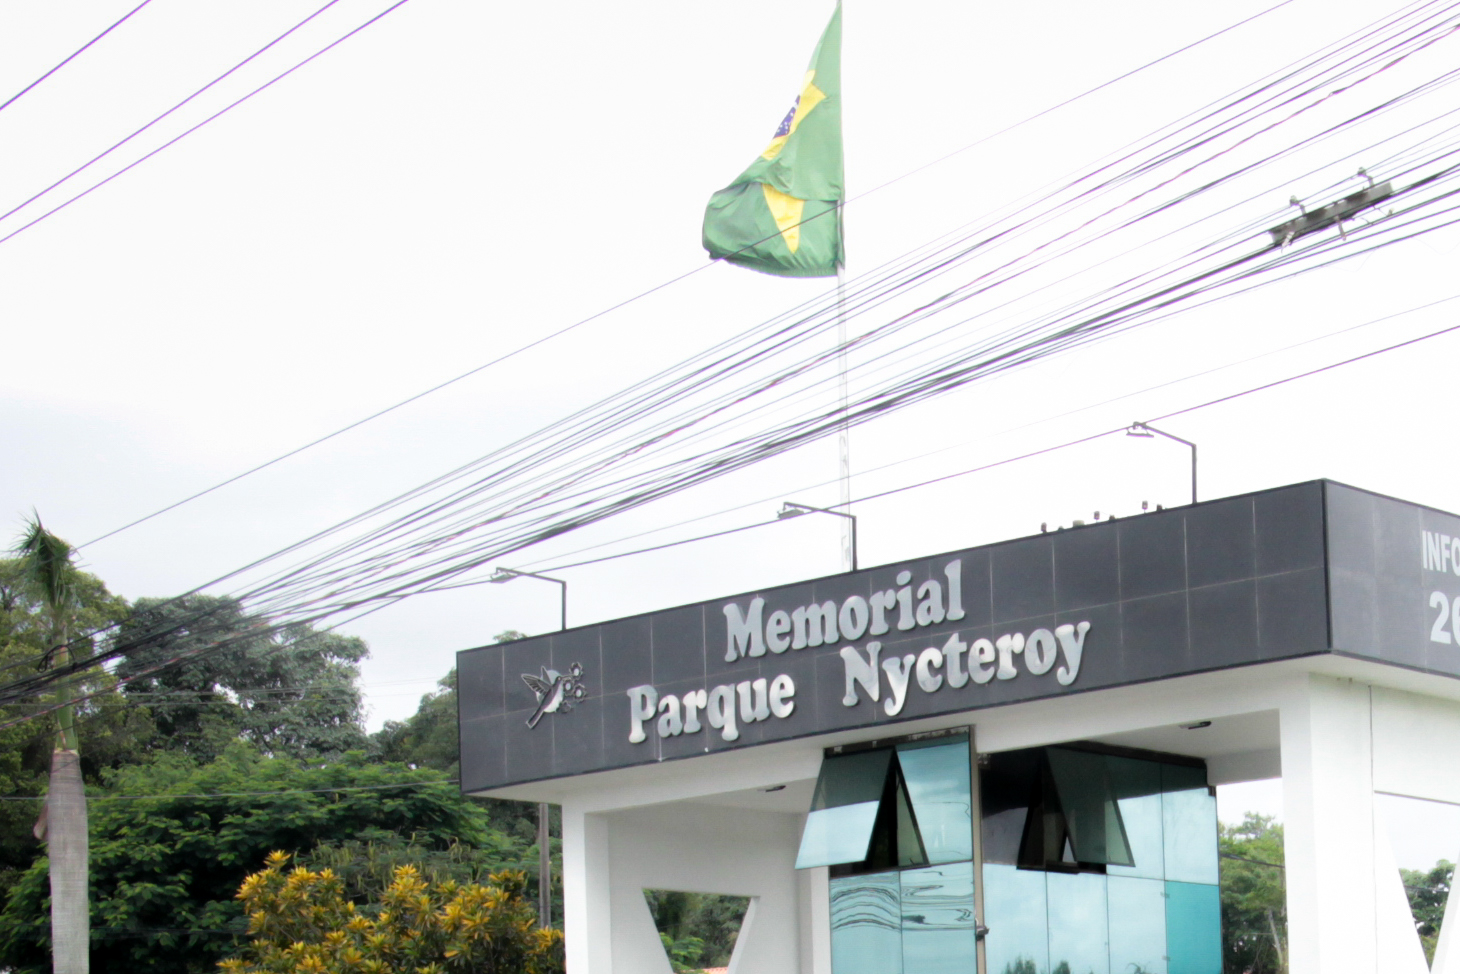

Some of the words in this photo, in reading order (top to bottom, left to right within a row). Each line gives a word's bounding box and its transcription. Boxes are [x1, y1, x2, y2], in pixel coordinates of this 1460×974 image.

[723, 559, 965, 662] Memorial
[627, 673, 796, 743] Parque
[840, 621, 1090, 716] Nycteroy
